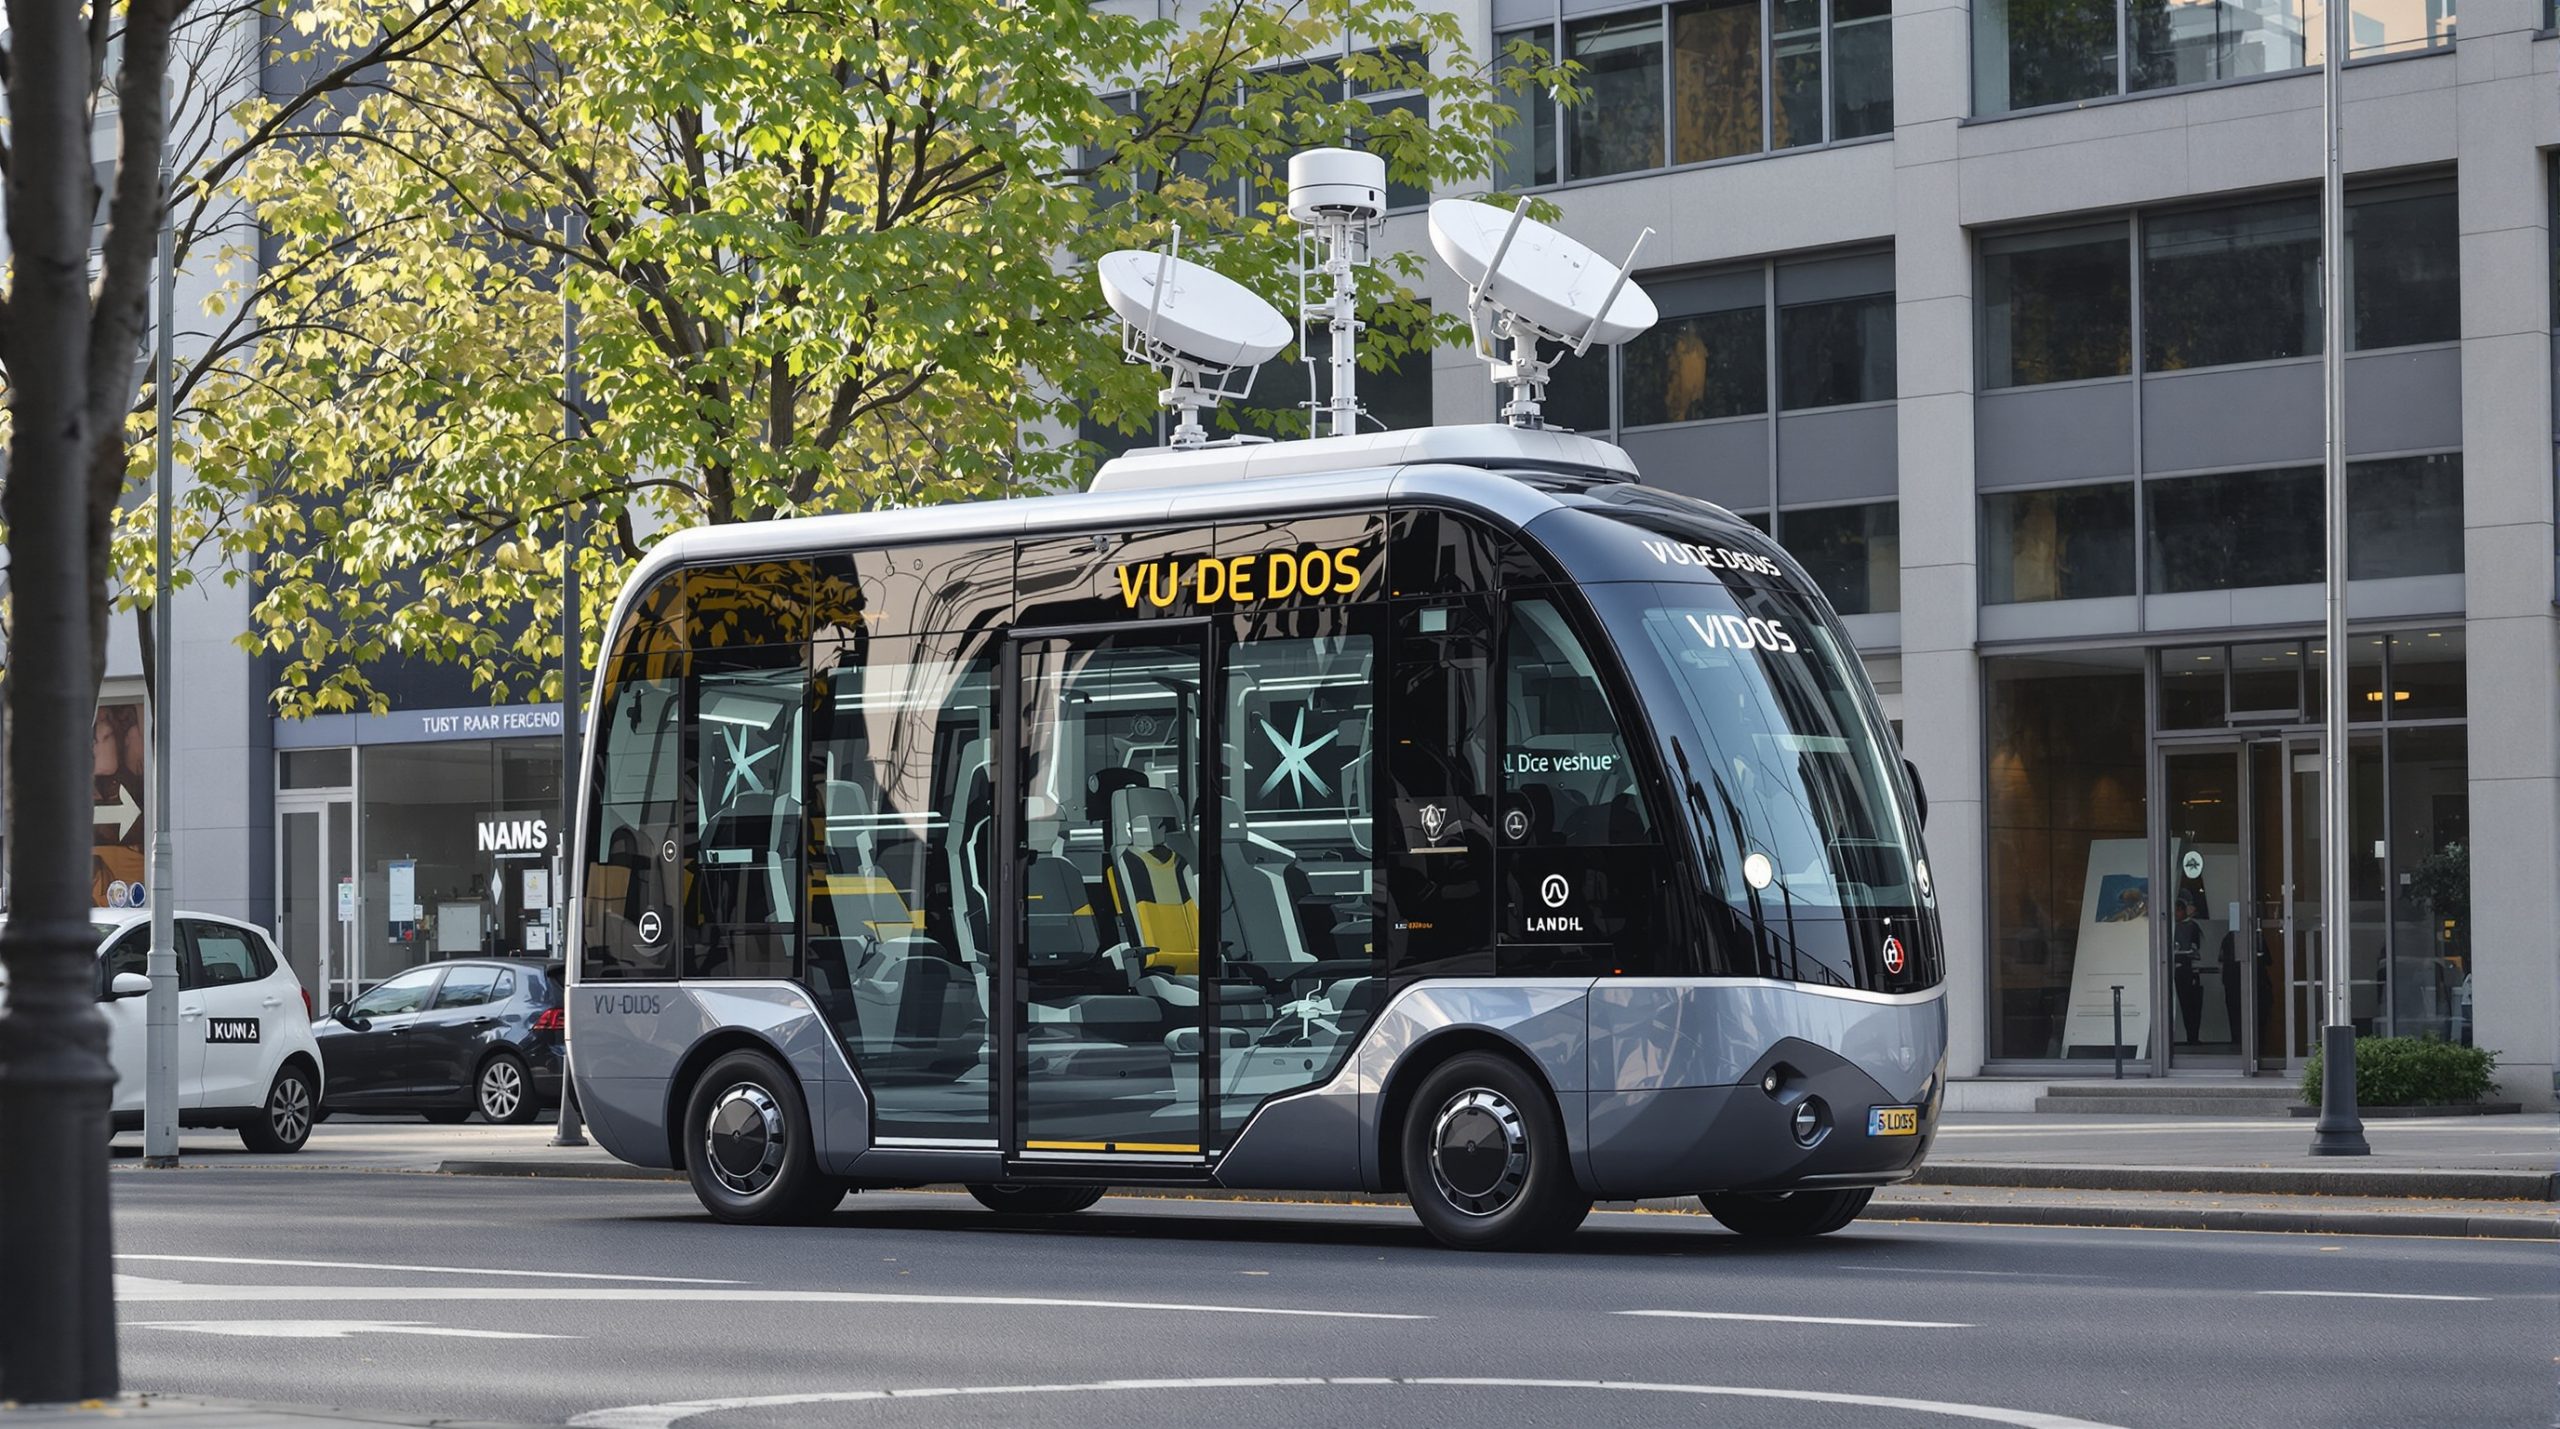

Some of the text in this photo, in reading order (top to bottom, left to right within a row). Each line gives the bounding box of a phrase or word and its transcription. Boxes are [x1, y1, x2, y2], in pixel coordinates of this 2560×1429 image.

[1268, 547, 1361, 599] DOS
[1685, 614, 1797, 654] VIDOS
[478, 820, 548, 851] NAMS
